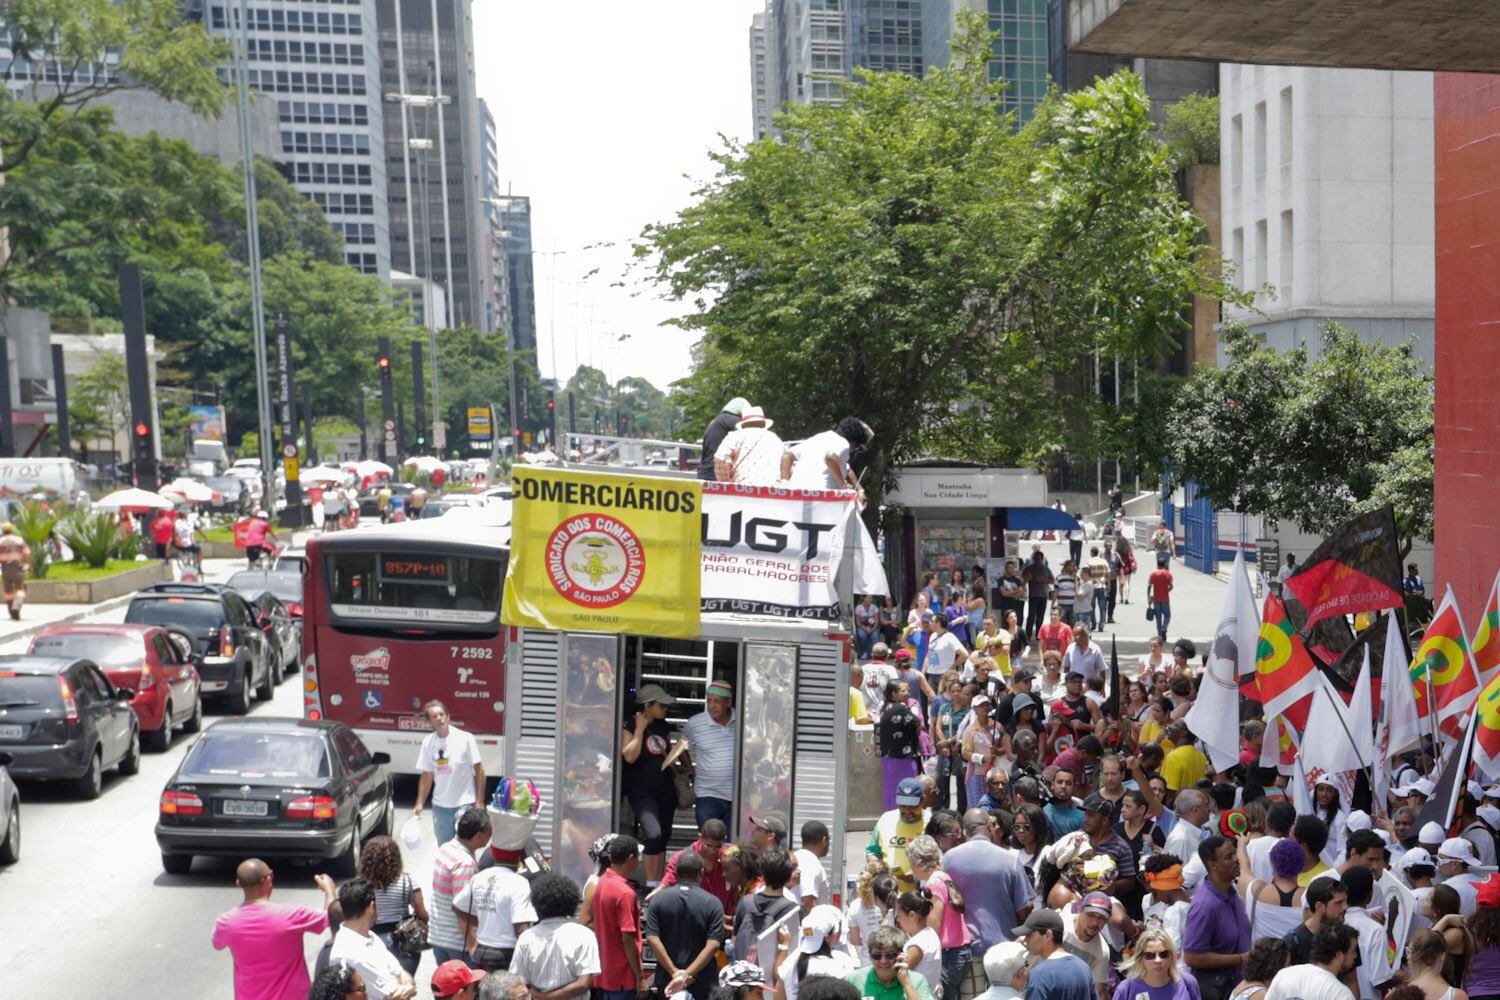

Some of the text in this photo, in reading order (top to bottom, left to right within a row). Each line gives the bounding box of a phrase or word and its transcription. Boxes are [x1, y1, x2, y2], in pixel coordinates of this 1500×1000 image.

[966, 492, 988, 500] Limpa
[701, 510, 837, 561] UGT
[549, 530, 572, 592] SINDICATO
[566, 517, 591, 536] DOS
[701, 554, 738, 564] NIÃO
[746, 559, 795, 572] GERAL
[701, 563, 827, 583] RABALHADORES
[573, 590, 620, 603] SÃO PAULO
[414, 609, 430, 617] 181
[731, 600, 760, 612] UGT
[763, 605, 792, 617] UGT
[796, 608, 824, 617] UGT
[572, 613, 620, 624] SÃO PAULO
[451, 647, 493, 659] 7 2592
